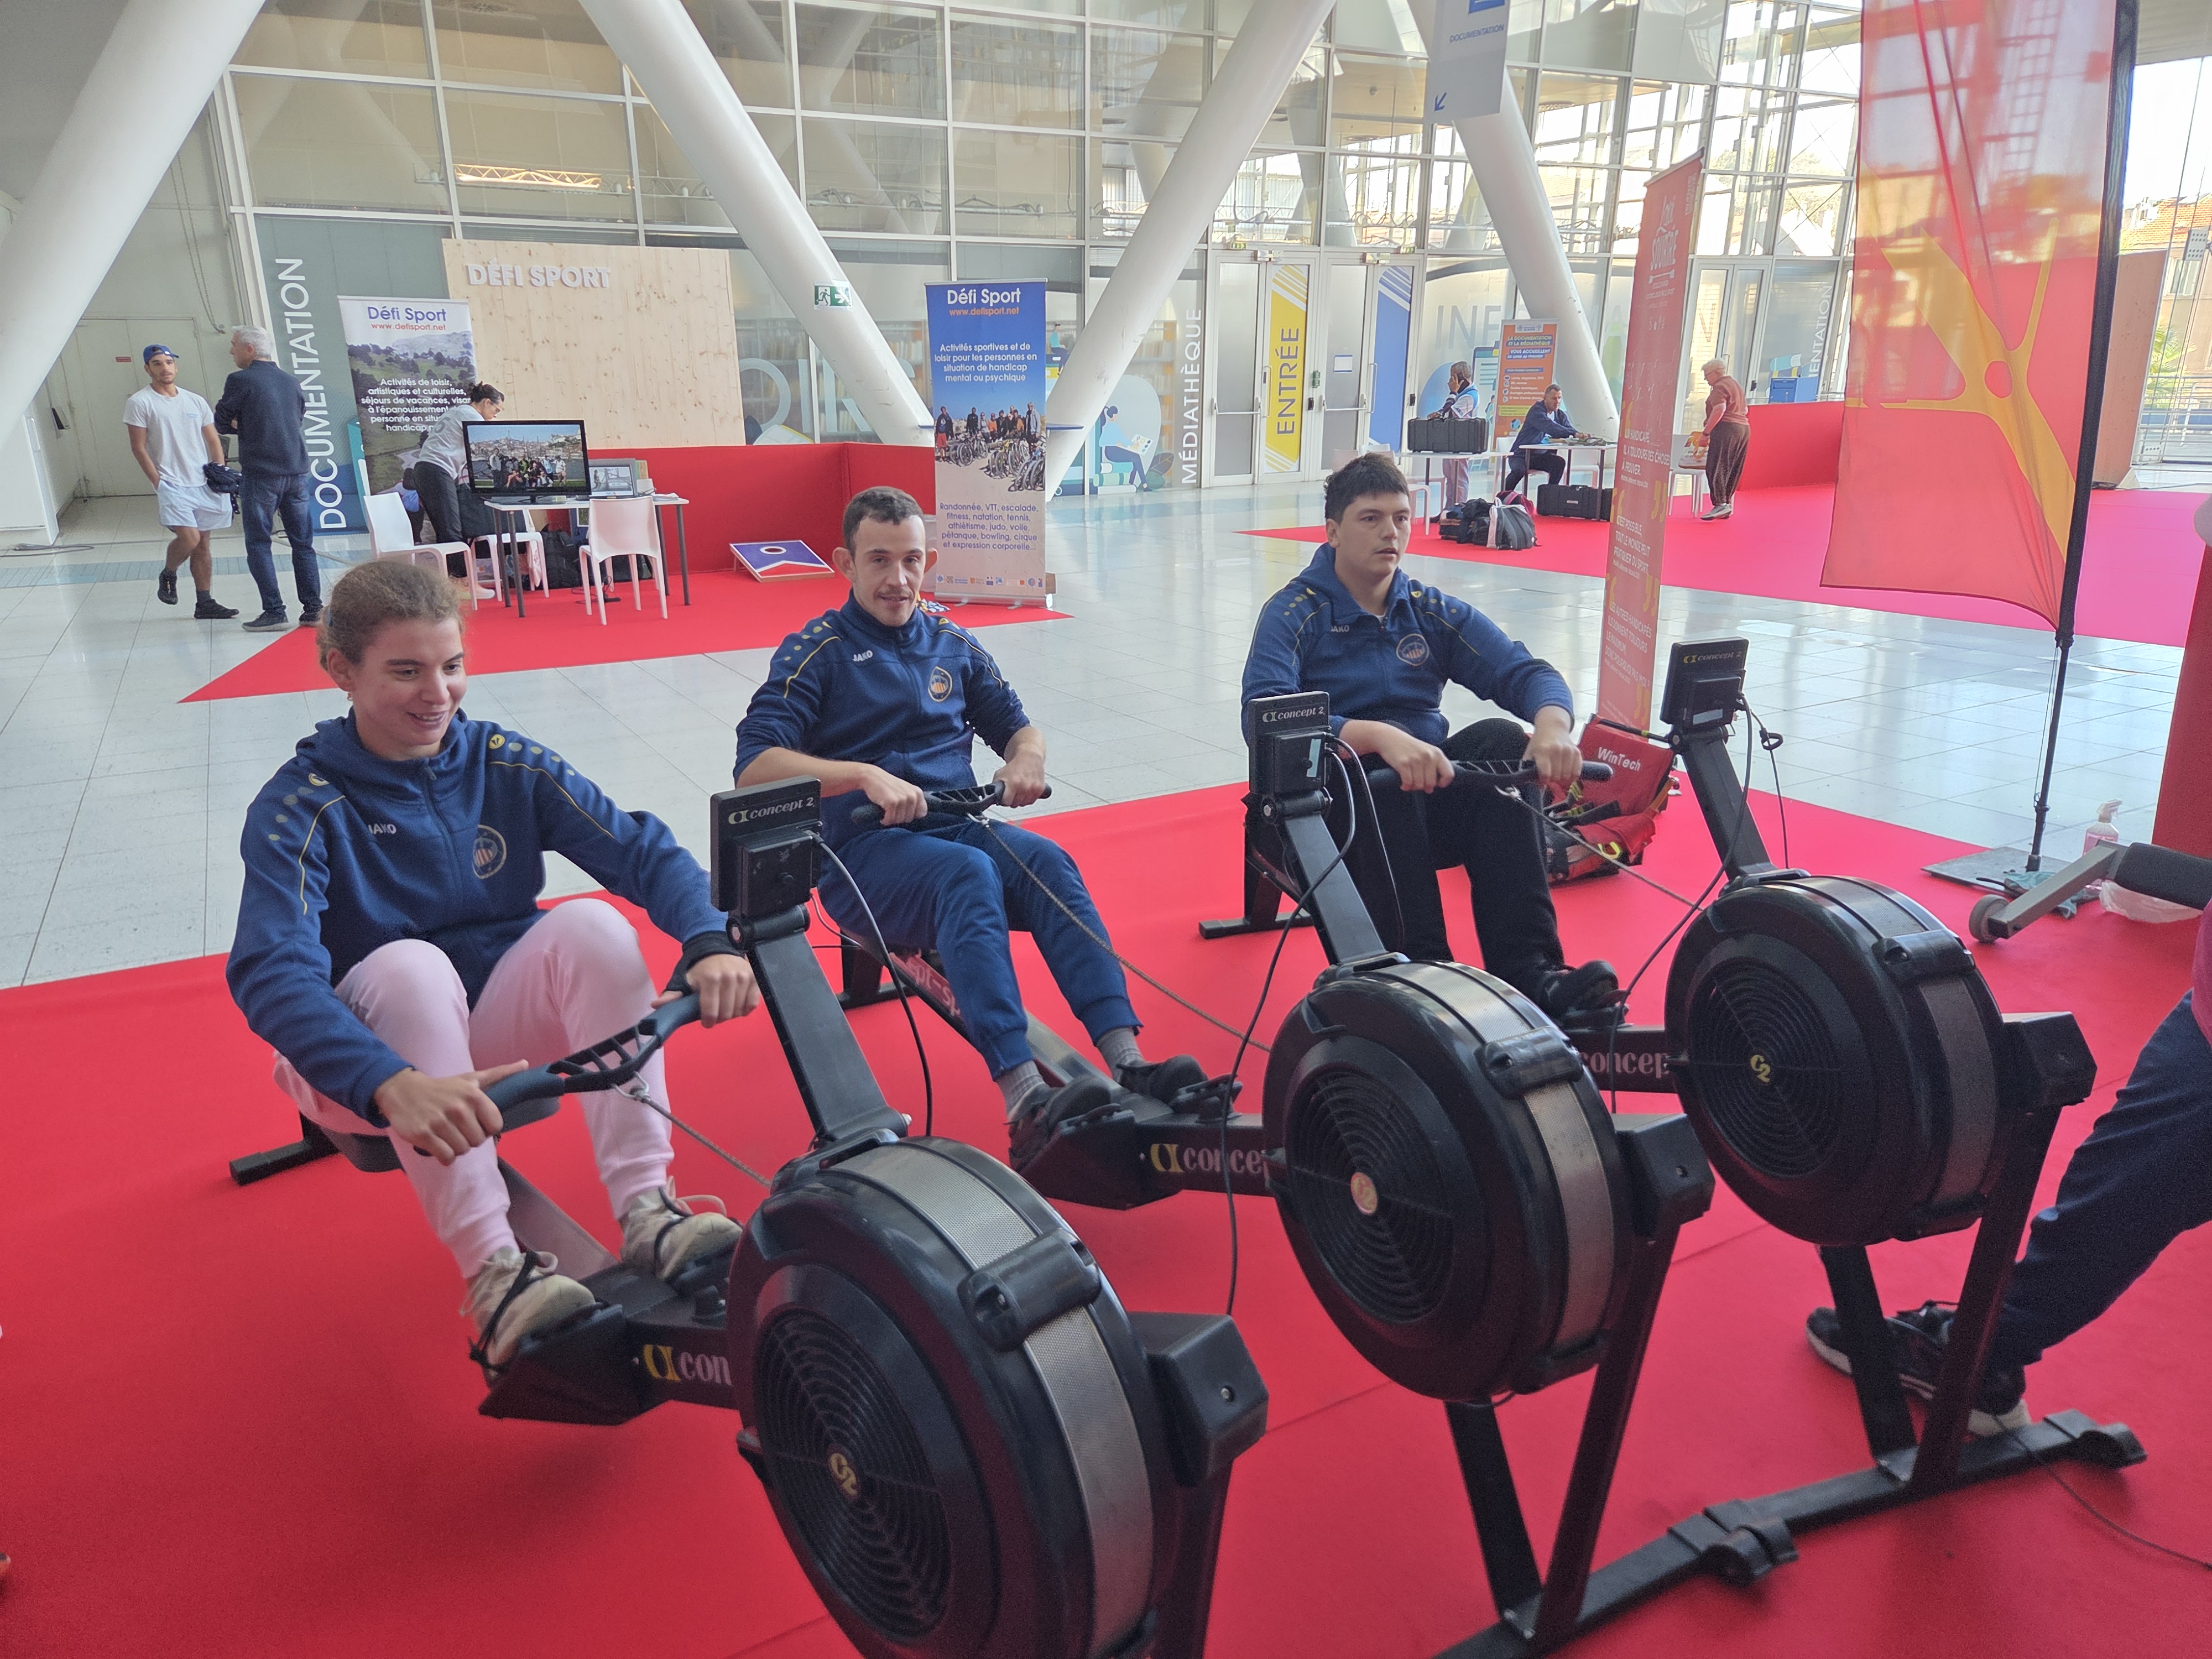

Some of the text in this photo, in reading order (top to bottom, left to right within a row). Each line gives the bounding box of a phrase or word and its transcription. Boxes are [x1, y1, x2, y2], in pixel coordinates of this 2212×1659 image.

[1449, 24, 1504, 43] DOCUMENTATION
[467, 259, 612, 288] DÉFI SPORT
[947, 288, 1021, 306] Défi Sport
[367, 306, 446, 324] Défi Sport
[949, 306, 1019, 316] www.defisport.net
[1808, 285, 1833, 377] ENTATION
[940, 343, 972, 352] Activités
[974, 343, 1008, 352] sportives
[935, 354, 951, 362] loisir
[984, 354, 1025, 362] personnes
[989, 364, 1027, 372] handicap
[946, 374, 972, 382] mental
[985, 373, 1026, 383] psychique
[1275, 327, 1300, 435] ENTRÉE
[275, 258, 346, 529] DOCUMENTATION
[1180, 307, 1202, 484] MÉDIATHÈQUE
[361, 397, 391, 405] séjours
[376, 405, 448, 414] l'épanouissement
[985, 504, 999, 512] VTT,
[947, 513, 971, 521] fitness,
[942, 532, 1037, 541] pétanque, bowling, cirque
[853, 650, 873, 662] JAKO
[1697, 652, 1734, 661] concept
[1277, 708, 1316, 719] concept
[1598, 747, 1641, 771] WinTech
[750, 800, 803, 819] concept
[806, 797, 814, 806] 2
